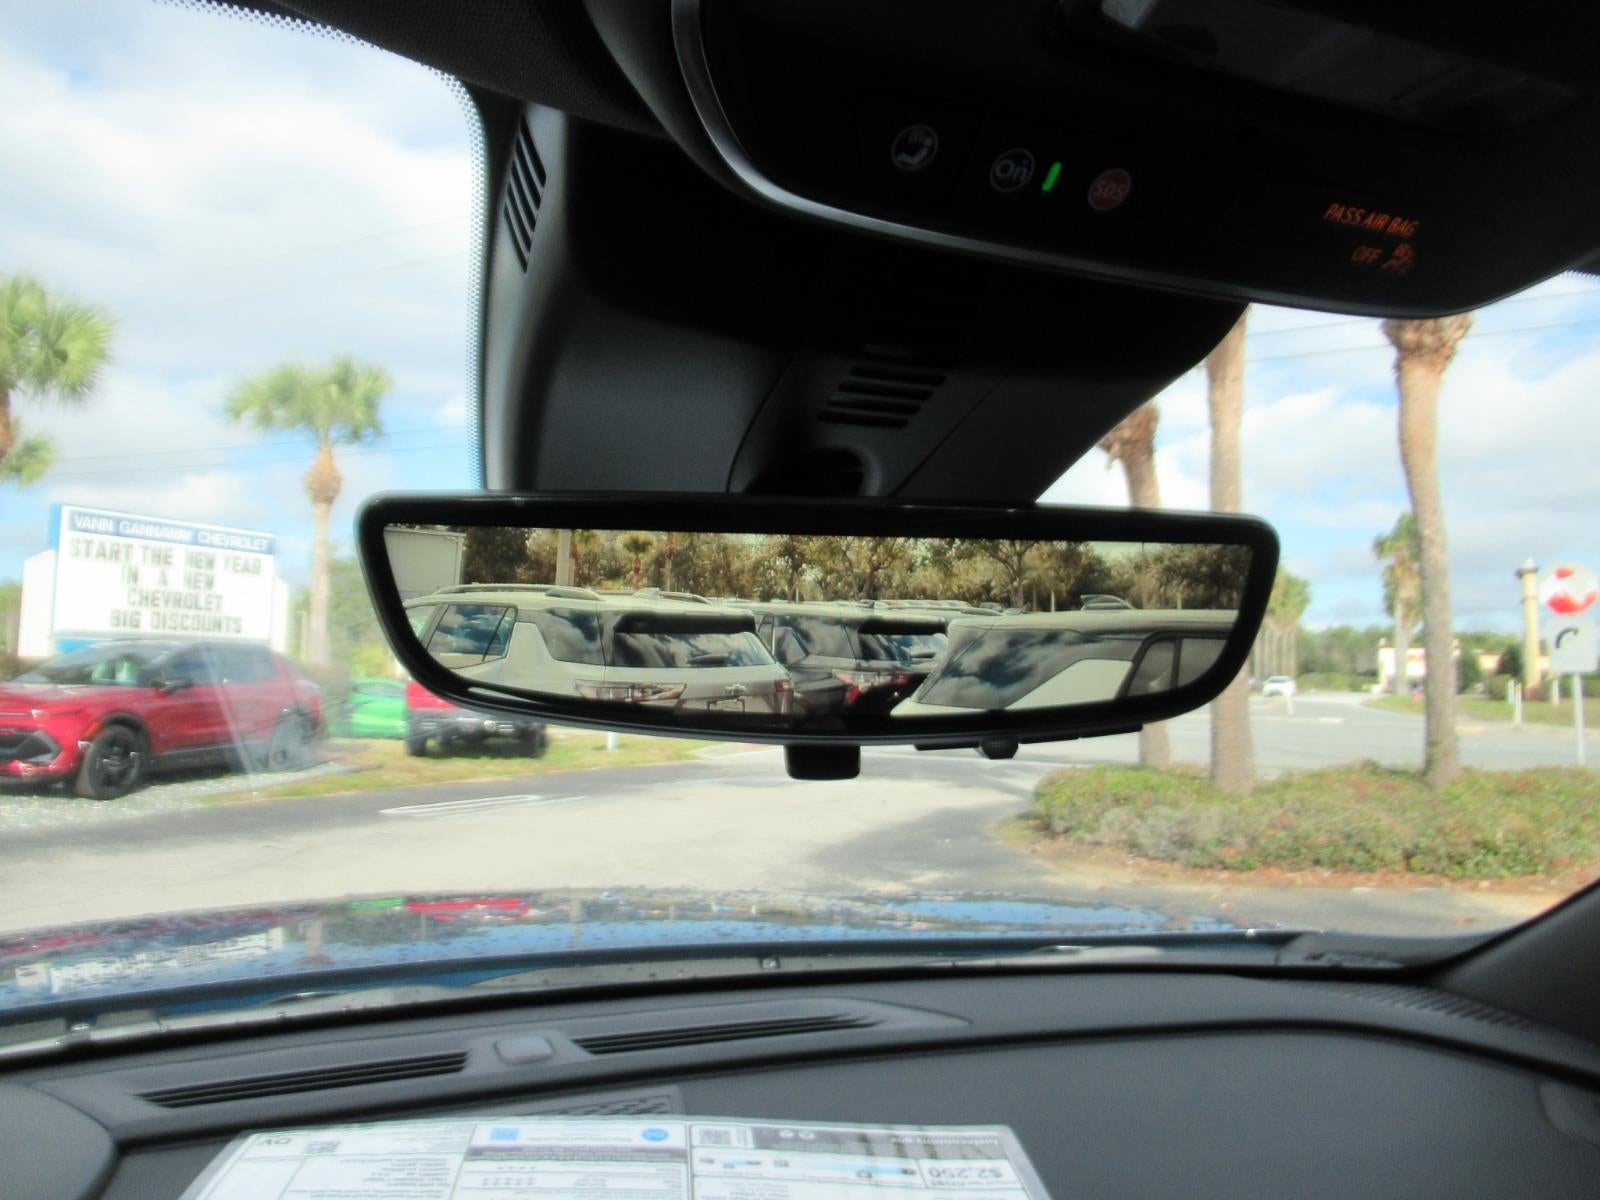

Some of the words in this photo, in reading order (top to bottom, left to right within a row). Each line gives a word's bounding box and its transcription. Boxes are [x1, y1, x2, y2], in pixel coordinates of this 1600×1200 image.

[995, 159, 1028, 181] On
[1092, 180, 1127, 201] SOS
[1323, 202, 1366, 225] PASS
[1362, 212, 1390, 231] AIR
[1386, 217, 1420, 237] BAG
[1351, 245, 1383, 265] OFF
[72, 513, 113, 532] VANN
[198, 531, 268, 552] CHEVROLET
[69, 537, 133, 563] START
[141, 545, 174, 566] THE
[184, 550, 216, 571] NEW
[222, 554, 262, 576] YEAR
[121, 564, 139, 585] IN
[158, 568, 169, 587] A
[182, 571, 215, 591] NEW
[126, 588, 224, 612] CHEVROLET
[110, 609, 142, 630] BIG
[151, 612, 242, 635] DISCOUNTS
